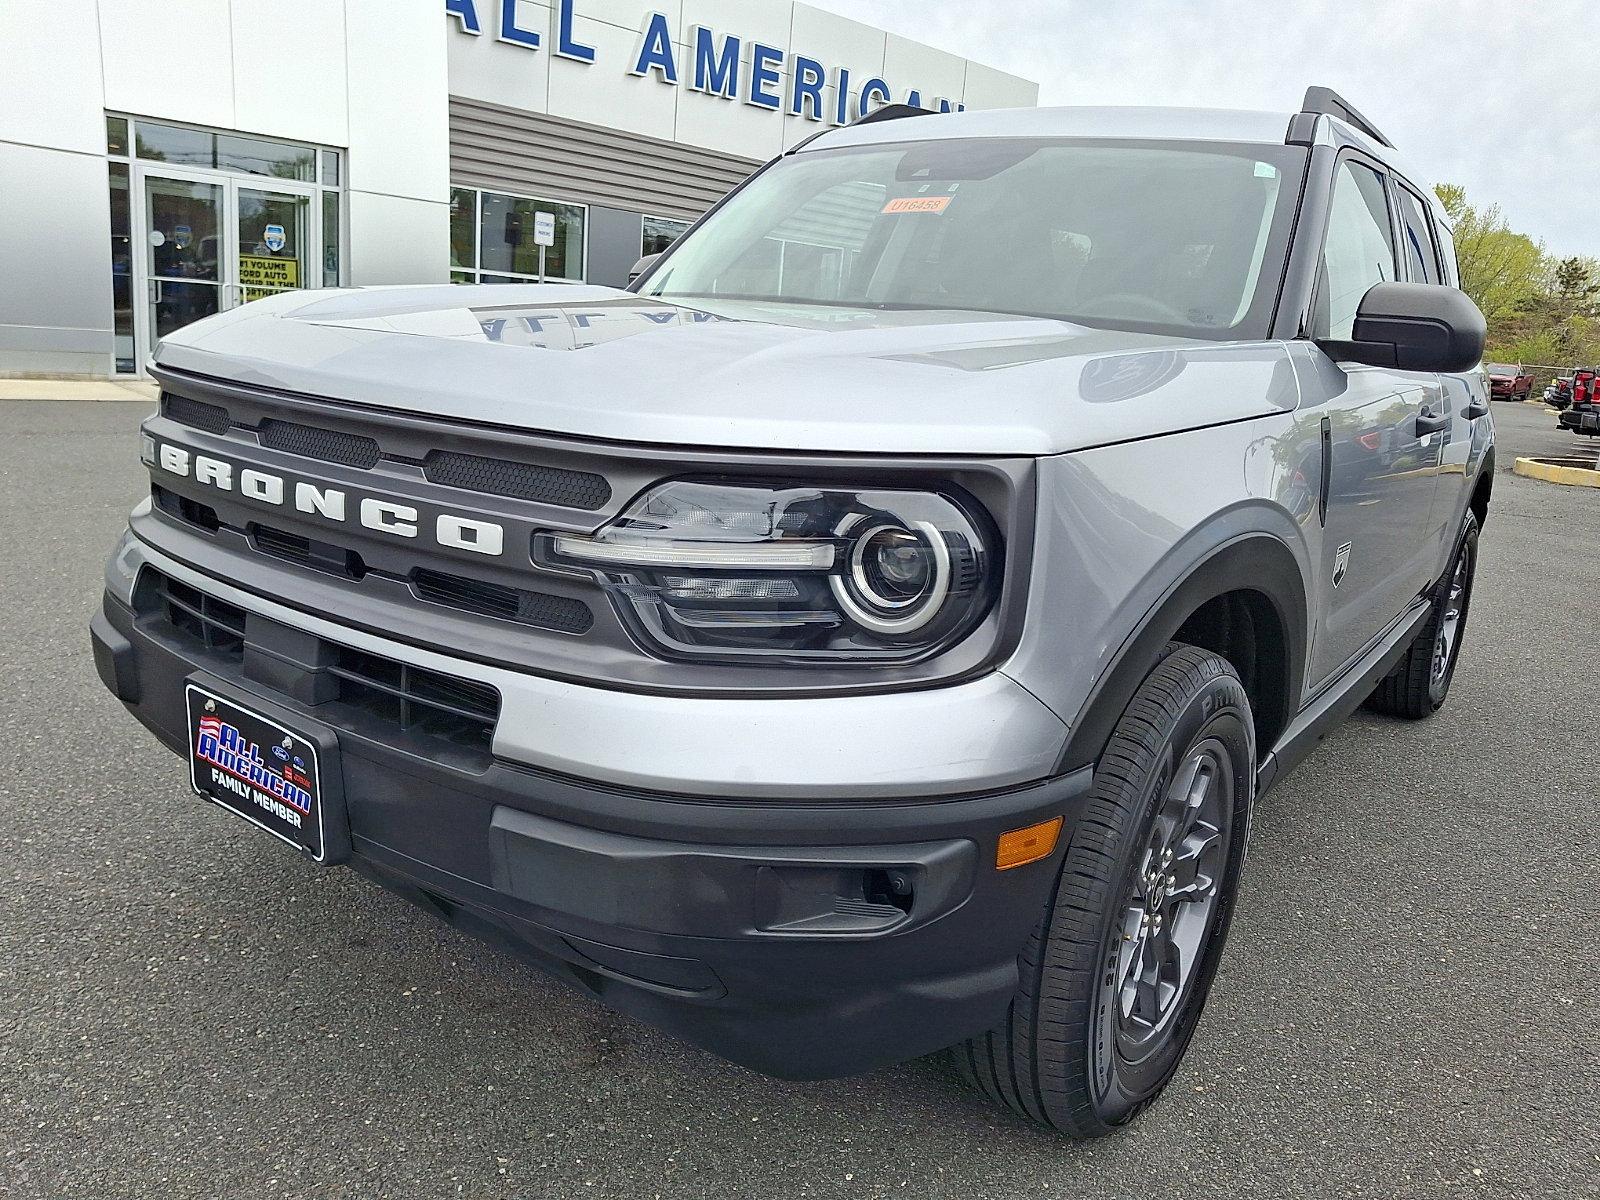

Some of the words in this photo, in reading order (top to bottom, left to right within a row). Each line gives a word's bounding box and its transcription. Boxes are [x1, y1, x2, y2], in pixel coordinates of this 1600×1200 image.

[627, 10, 966, 126] AMERIC
[891, 200, 941, 211] U16458
[251, 261, 286, 271] VOLUME
[264, 271, 288, 280] AUTO
[159, 442, 504, 556] BRONCO
[218, 721, 264, 767] ALL
[197, 732, 312, 814] AMERICAN
[211, 767, 253, 801] FAMILY
[253, 789, 302, 830] MEMBER
